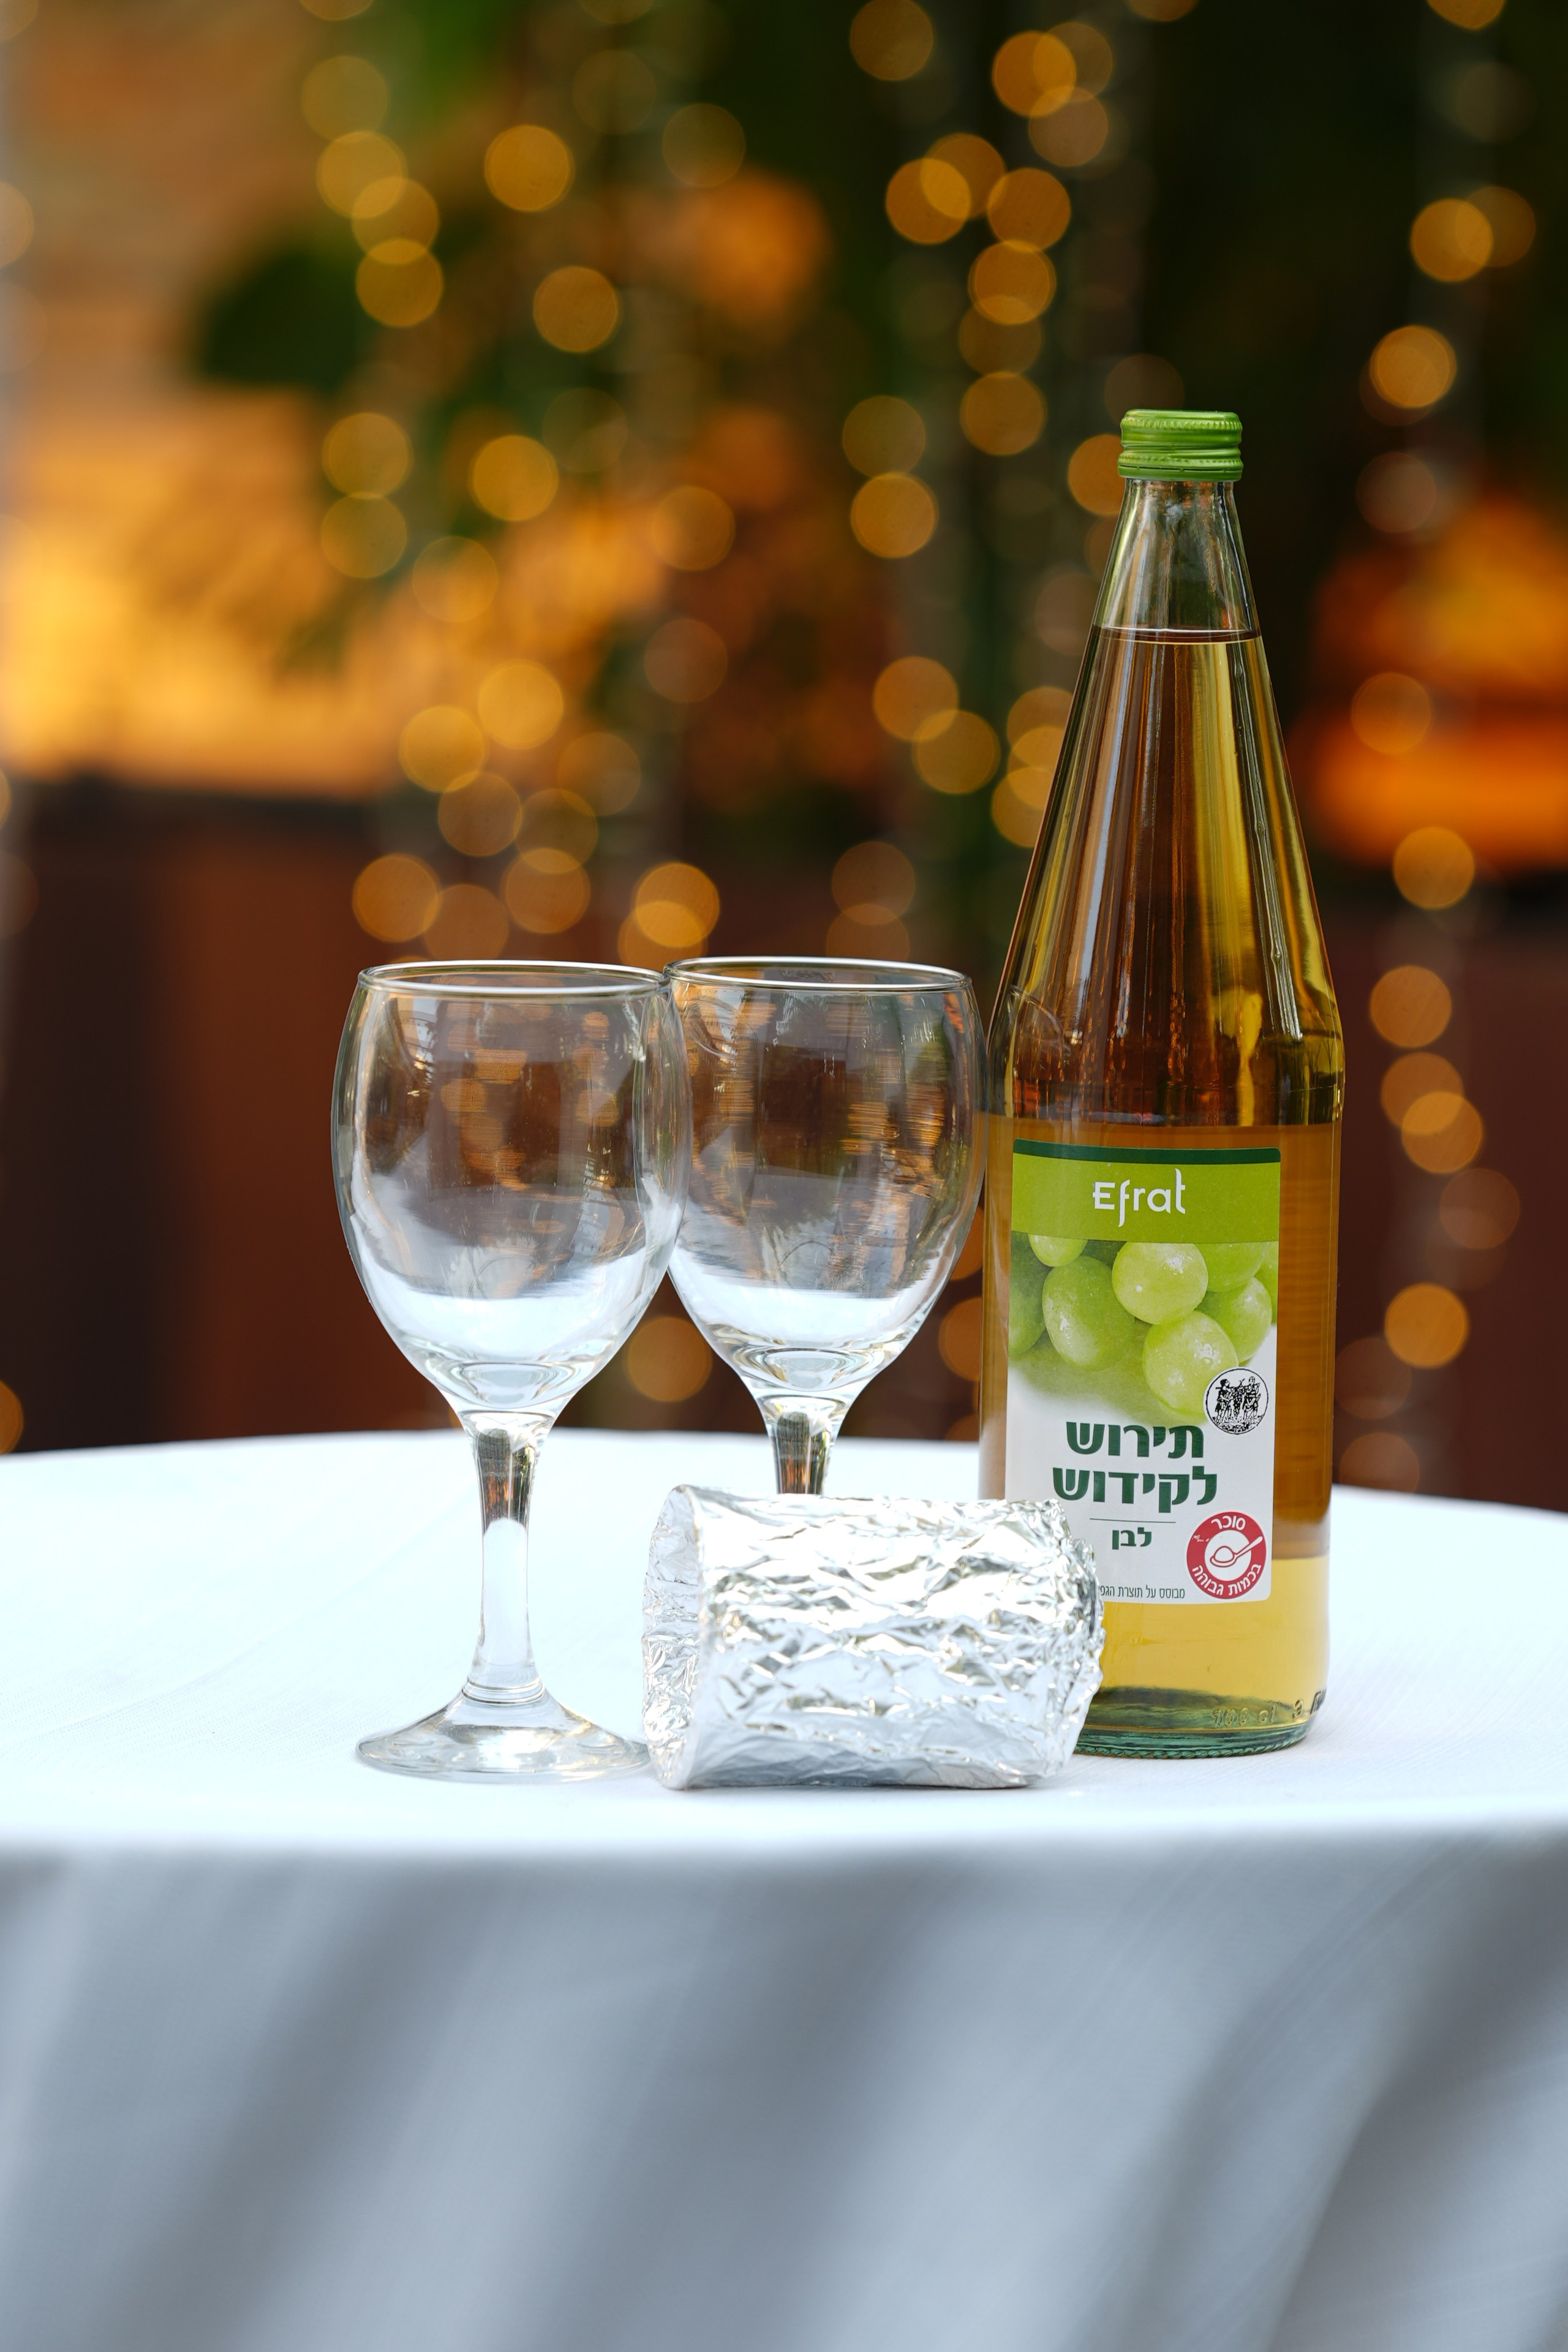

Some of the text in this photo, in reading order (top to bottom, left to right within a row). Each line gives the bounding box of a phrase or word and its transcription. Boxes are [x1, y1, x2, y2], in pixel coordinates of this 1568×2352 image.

[1092, 1168, 1186, 1227] Efrat
[1066, 1421, 1204, 1459] תירוש
[1052, 1466, 1218, 1513] לקידוש
[1112, 1527, 1152, 1550] לבן
[1210, 1515, 1246, 1531] סוכר
[1099, 1585, 1185, 1599] מבוסס על תוצרת הגפ
[1192, 1564, 1262, 1596] בכמות גבוהה
